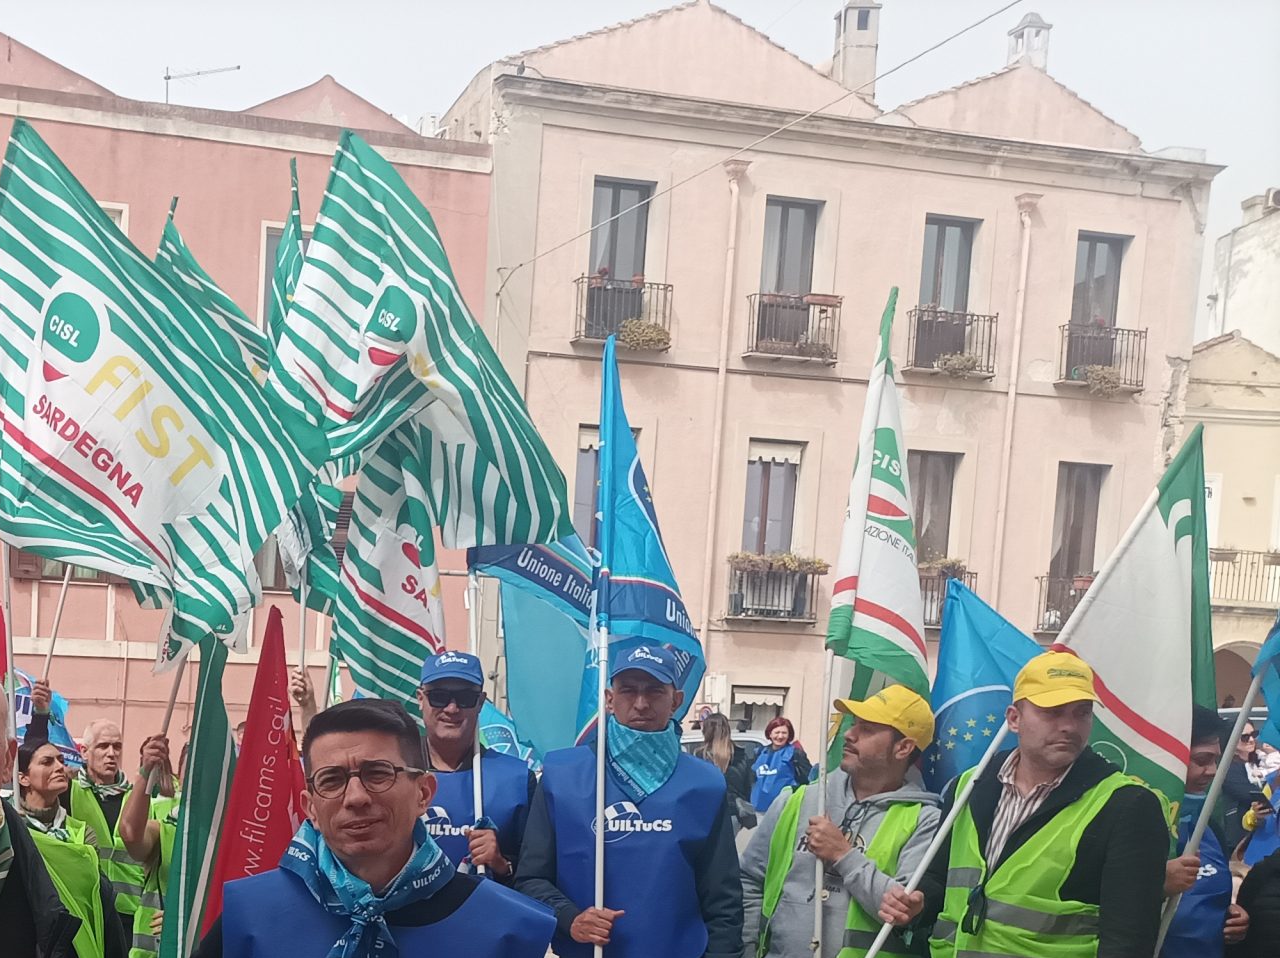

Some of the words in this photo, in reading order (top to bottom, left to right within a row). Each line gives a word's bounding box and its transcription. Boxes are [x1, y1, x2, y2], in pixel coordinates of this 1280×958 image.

[50, 314, 81, 348] CISL
[84, 355, 215, 487] FIST
[32, 394, 144, 508] SARDEGNA
[873, 449, 901, 477] CIS
[864, 525, 902, 550] AZIONE
[517, 547, 565, 587] Unione
[608, 819, 673, 833] UILTuCS
